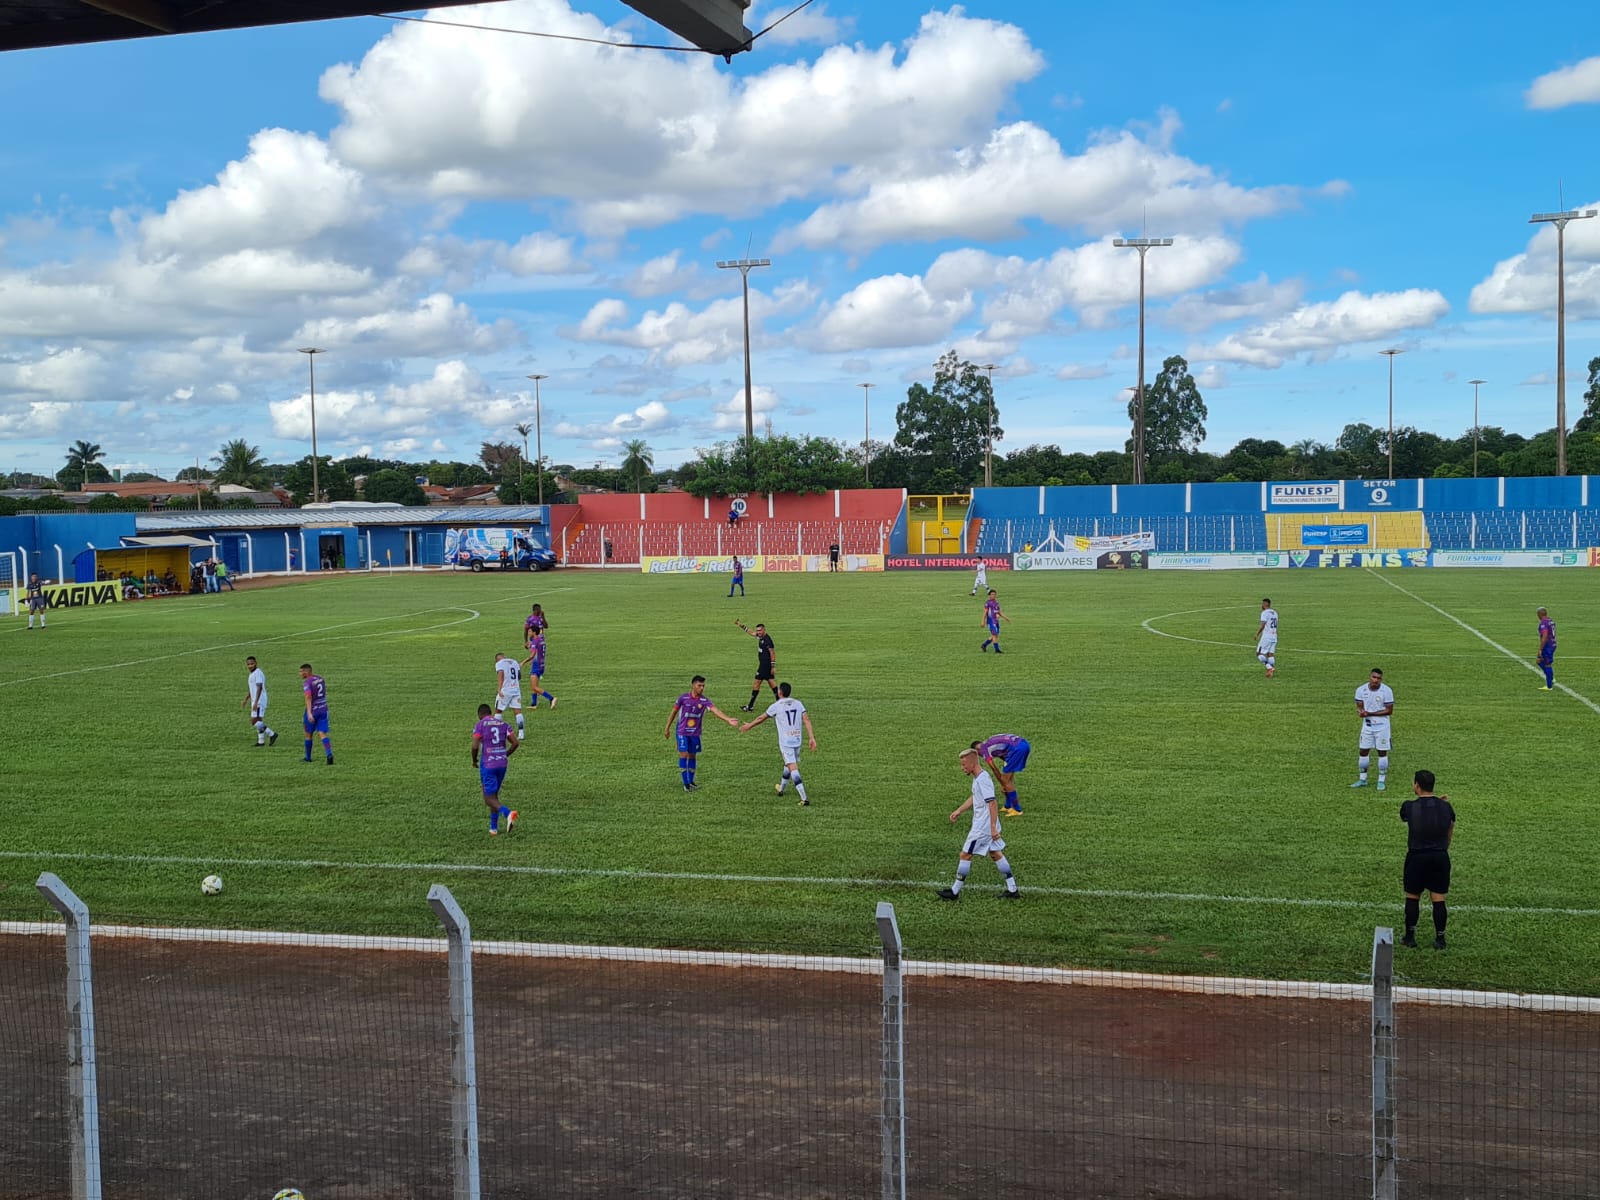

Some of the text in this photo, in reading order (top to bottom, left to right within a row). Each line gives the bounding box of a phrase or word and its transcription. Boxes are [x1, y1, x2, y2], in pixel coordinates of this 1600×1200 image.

[1363, 480, 1396, 488] SETOR
[1275, 486, 1333, 496] FUNESP
[1375, 490, 1383, 500] 9
[734, 502, 744, 511] 10
[650, 557, 698, 573] Refriko
[888, 558, 1010, 567] HOTEL INTERNACONAL
[1034, 557, 1093, 566] M TAVARES
[42, 584, 118, 609] KAGIVA
[1270, 617, 1278, 629] 20
[510, 667, 517, 680] 9
[317, 683, 324, 697] 2
[785, 709, 797, 726] 17
[490, 726, 500, 744] 3
